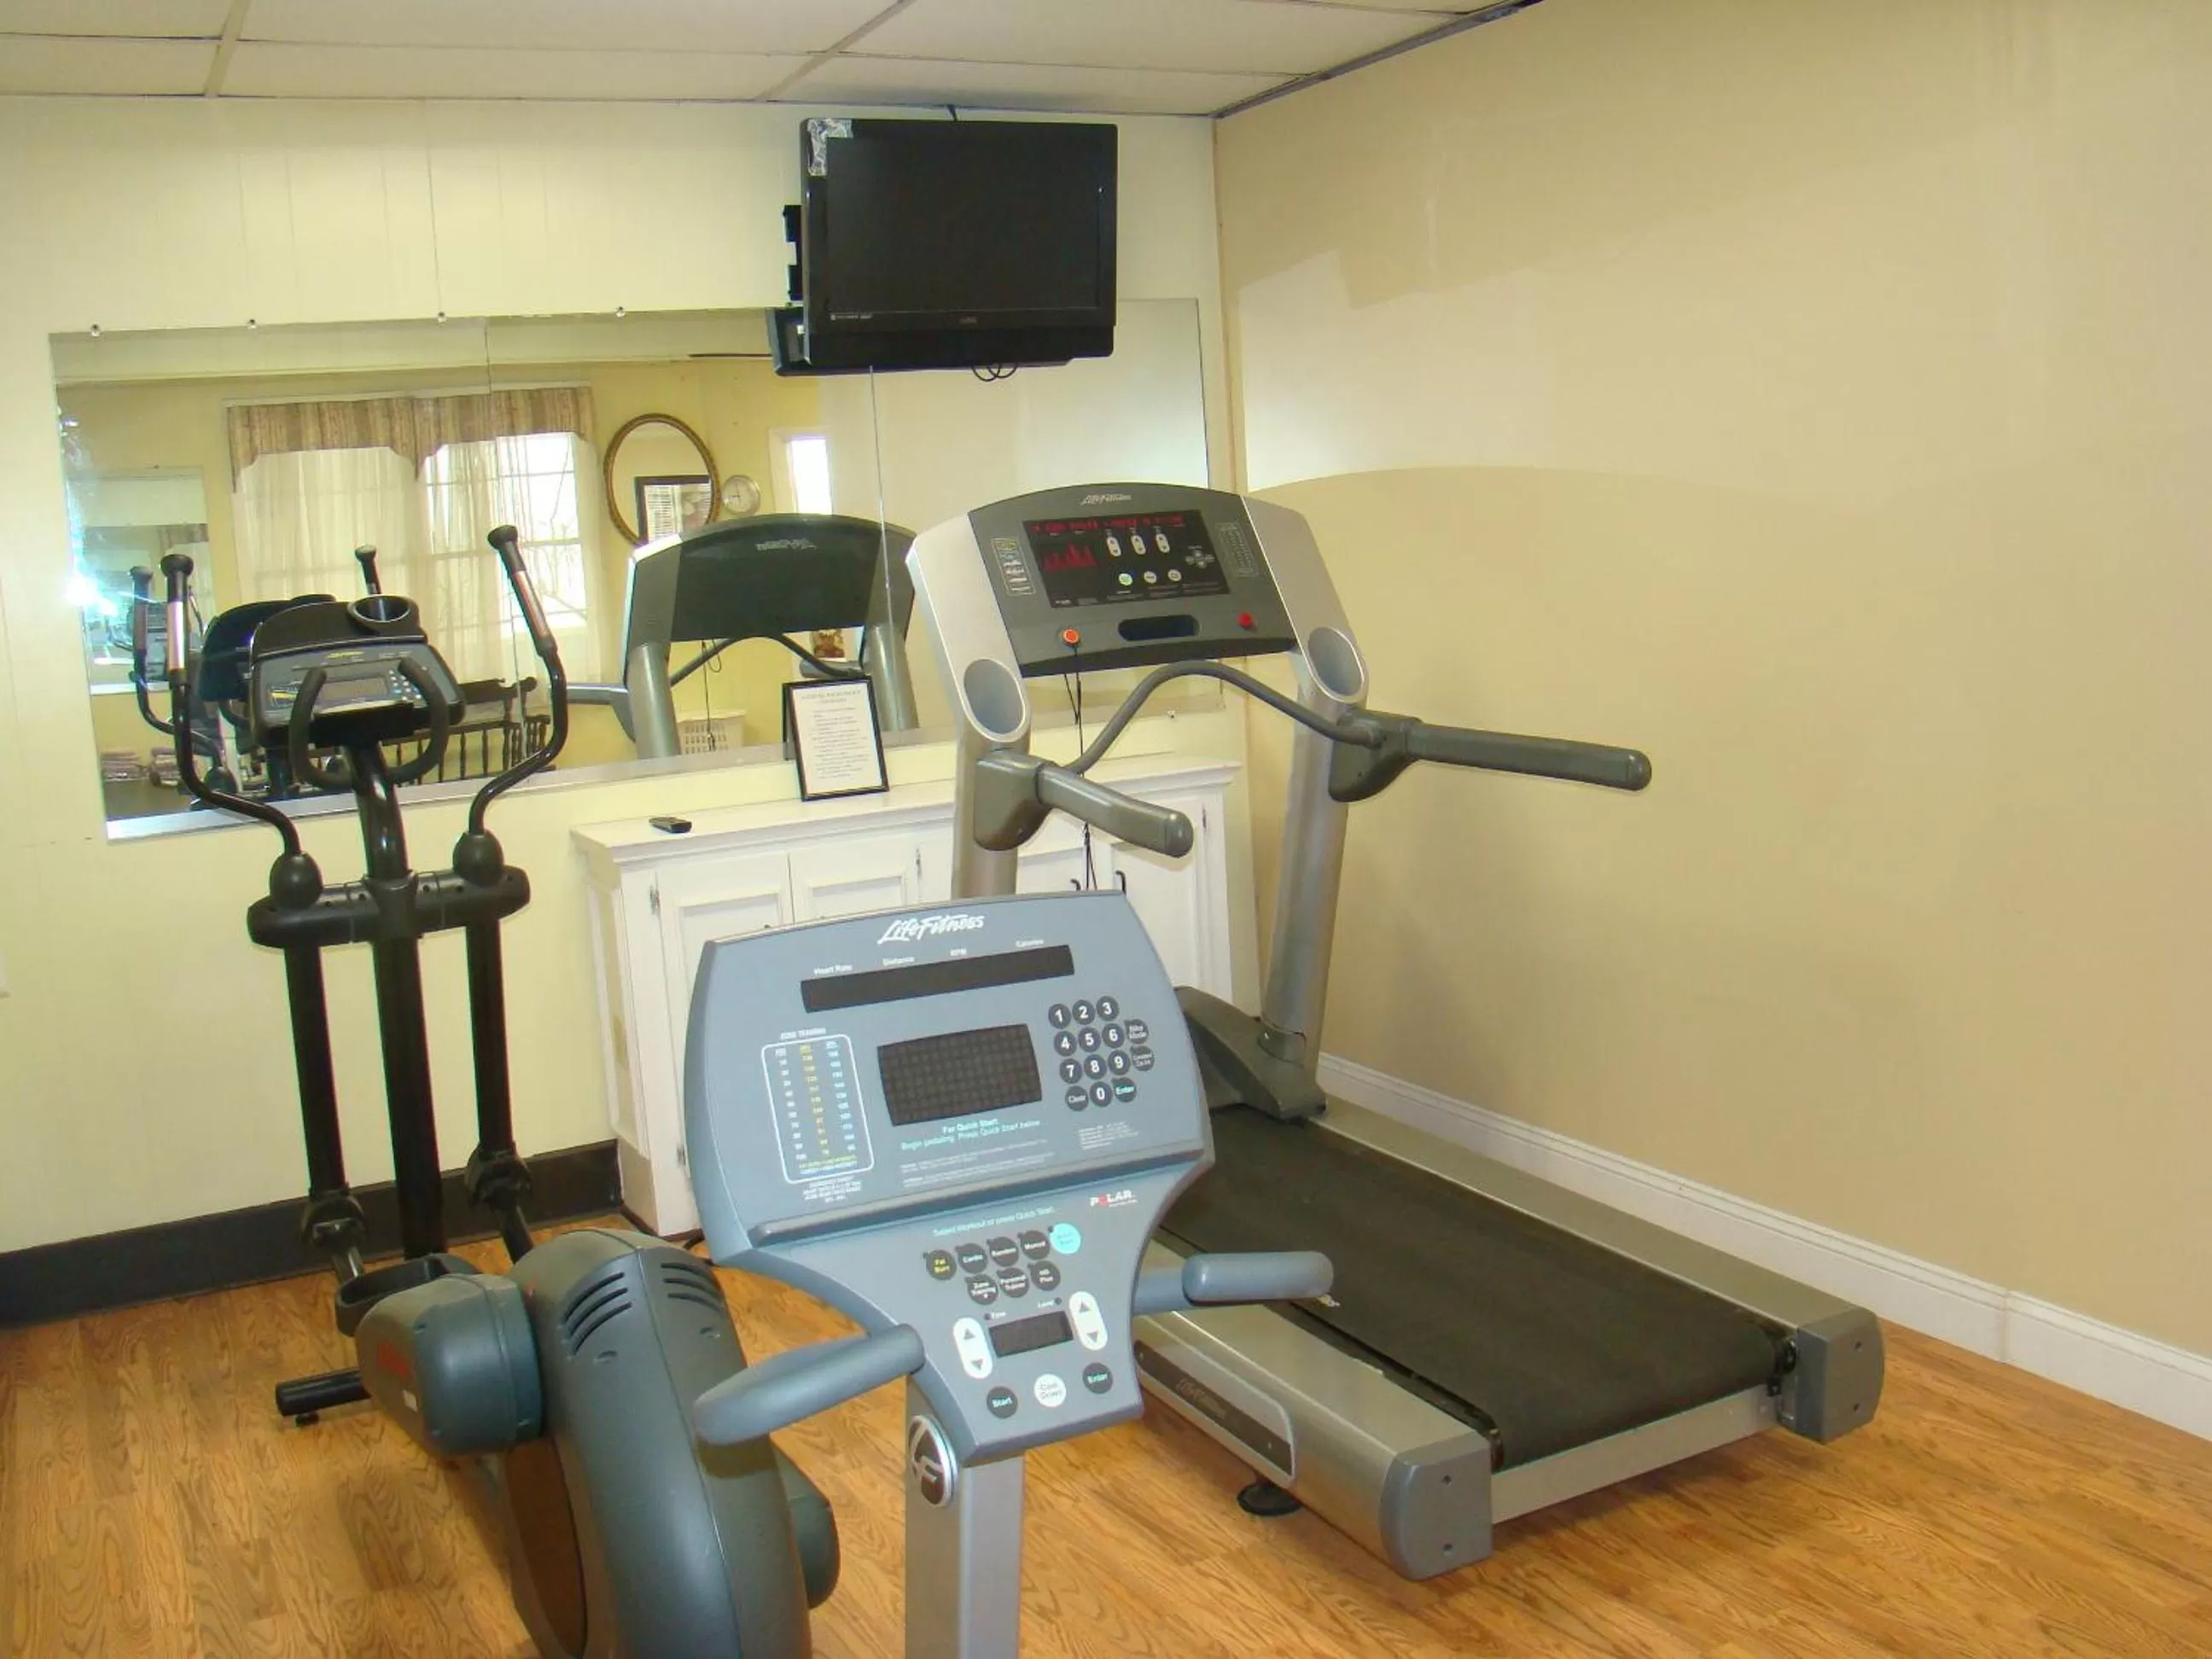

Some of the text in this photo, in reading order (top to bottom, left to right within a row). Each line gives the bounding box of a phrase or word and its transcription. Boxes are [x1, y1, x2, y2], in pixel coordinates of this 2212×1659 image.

[1055, 1009, 1063, 1023] 1
[1079, 1005, 1089, 1019] 2
[1102, 1002, 1112, 1016] 3
[1085, 1033, 1094, 1046] 5
[1109, 1028, 1119, 1042] 6
[1061, 1035, 1070, 1050] 4
[1090, 1059, 1100, 1073] 8
[1114, 1055, 1124, 1069] 9
[1065, 1064, 1074, 1078] 7
[1096, 1086, 1105, 1100] 0
